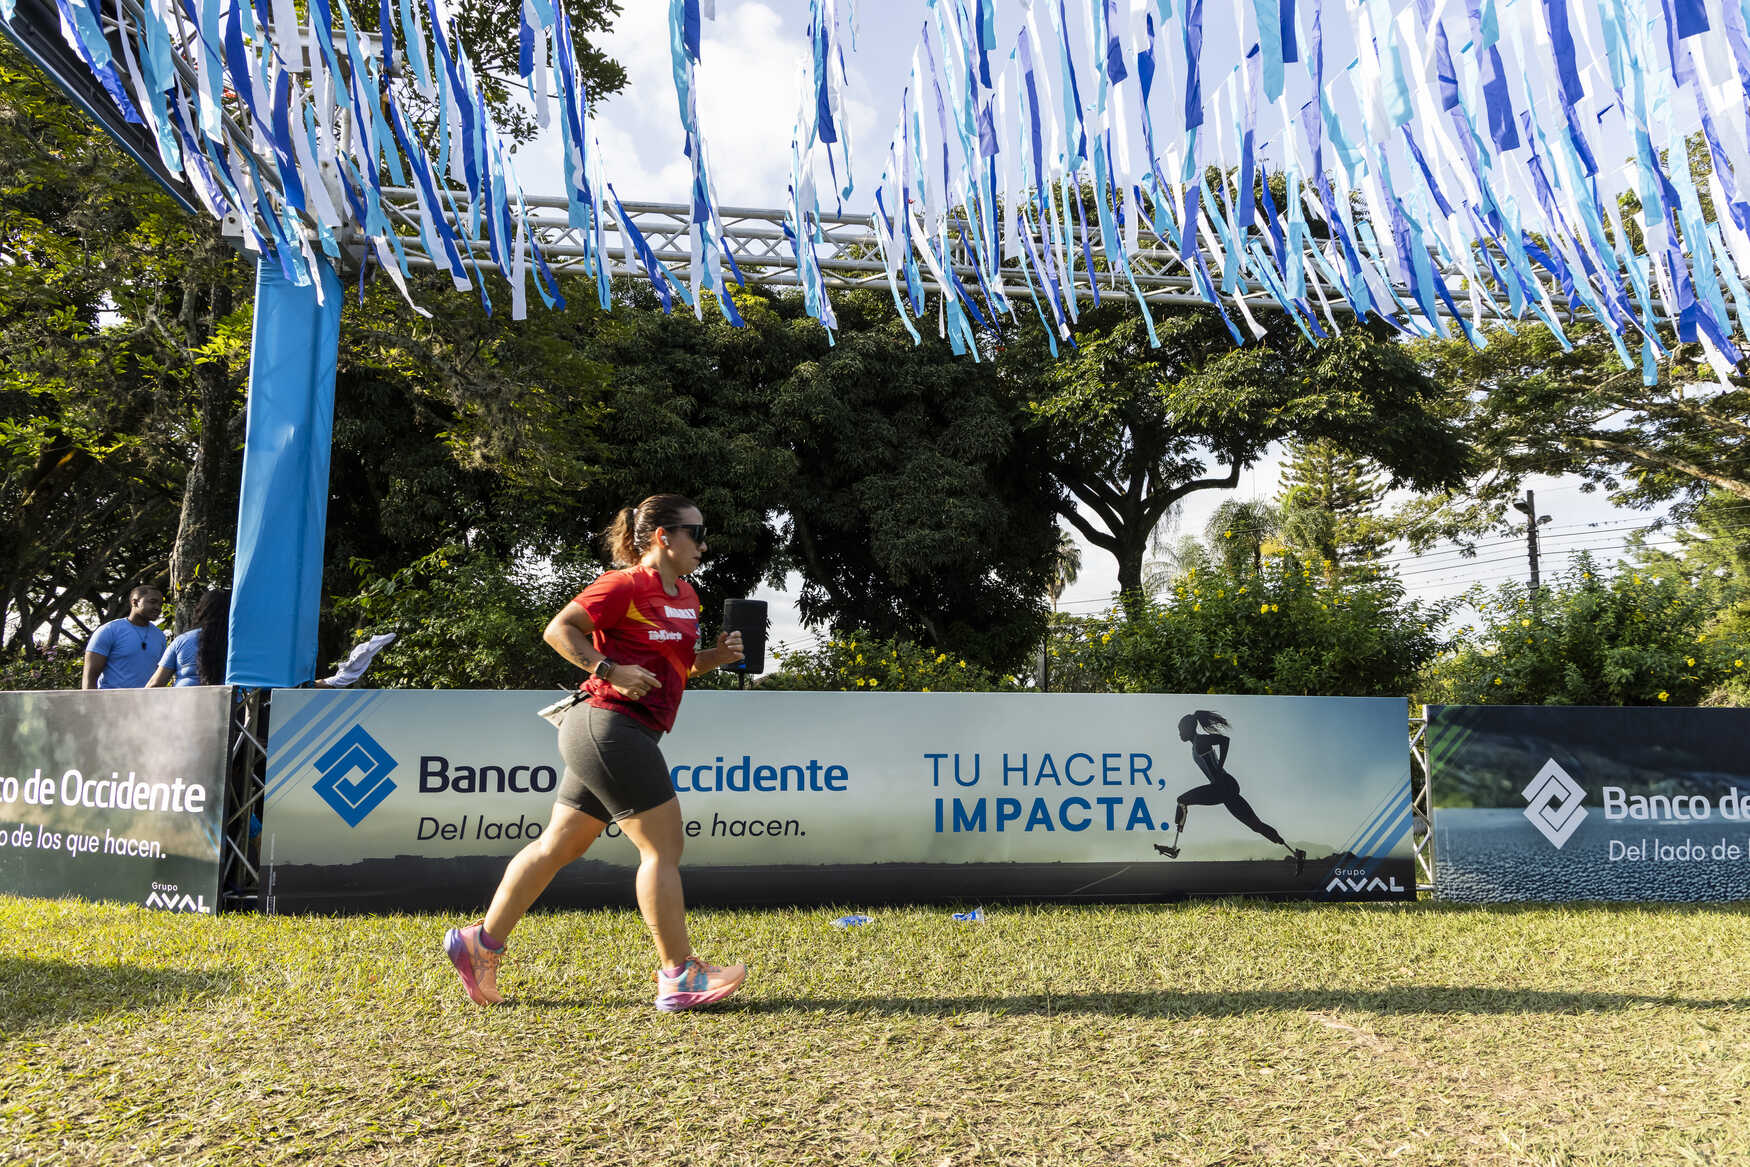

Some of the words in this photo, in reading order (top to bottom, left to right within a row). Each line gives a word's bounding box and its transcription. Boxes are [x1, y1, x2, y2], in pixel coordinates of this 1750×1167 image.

[418, 756, 557, 793] Banco
[671, 755, 848, 792] ccidente
[924, 753, 981, 786] TU
[1002, 752, 1167, 790] HACER,
[23, 768, 55, 805] de
[61, 769, 206, 812] Occidente
[1603, 786, 1711, 820] Banco
[417, 816, 468, 840] Del
[476, 815, 543, 840] lado
[711, 813, 807, 837] hacen.
[934, 796, 1170, 833] IMPACTA.
[11, 823, 33, 848] de
[37, 824, 62, 850] los
[66, 833, 100, 857] que
[104, 828, 167, 859] hacen.
[1608, 839, 1646, 861] Del
[1654, 838, 1706, 861] lado
[1711, 837, 1741, 860] de
[151, 882, 178, 891] Grupo
[1326, 876, 1405, 892] AVAL
[1334, 867, 1366, 877] Grupo
[145, 891, 211, 914] AVAL
